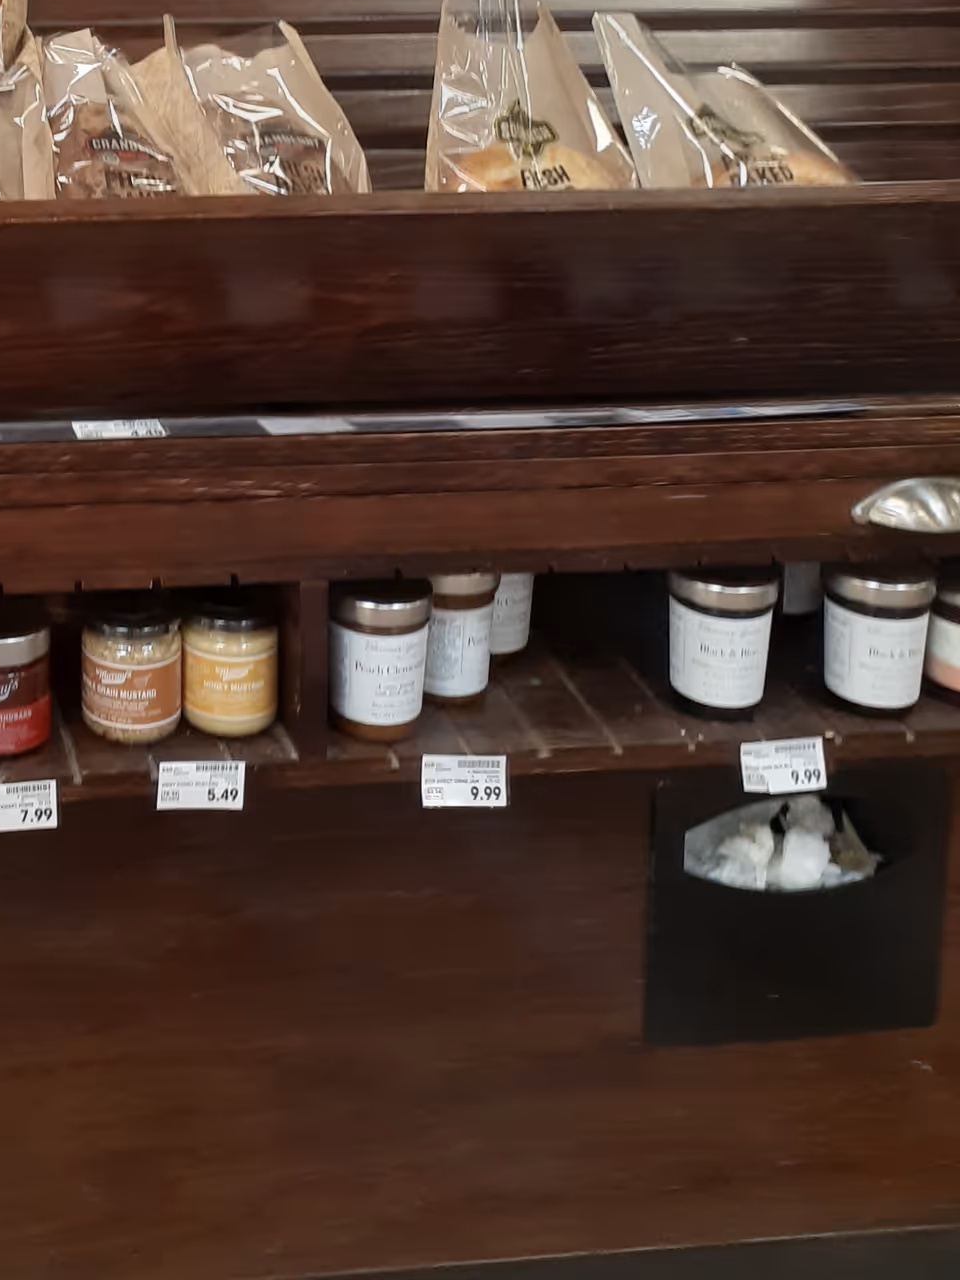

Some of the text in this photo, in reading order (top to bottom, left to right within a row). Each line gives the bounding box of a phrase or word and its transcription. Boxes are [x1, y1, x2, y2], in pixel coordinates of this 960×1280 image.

[791, 768, 821, 785] 9.99
[207, 787, 239, 802] 5.49
[470, 785, 502, 801] 9.99
[20, 807, 53, 824] 7.99
